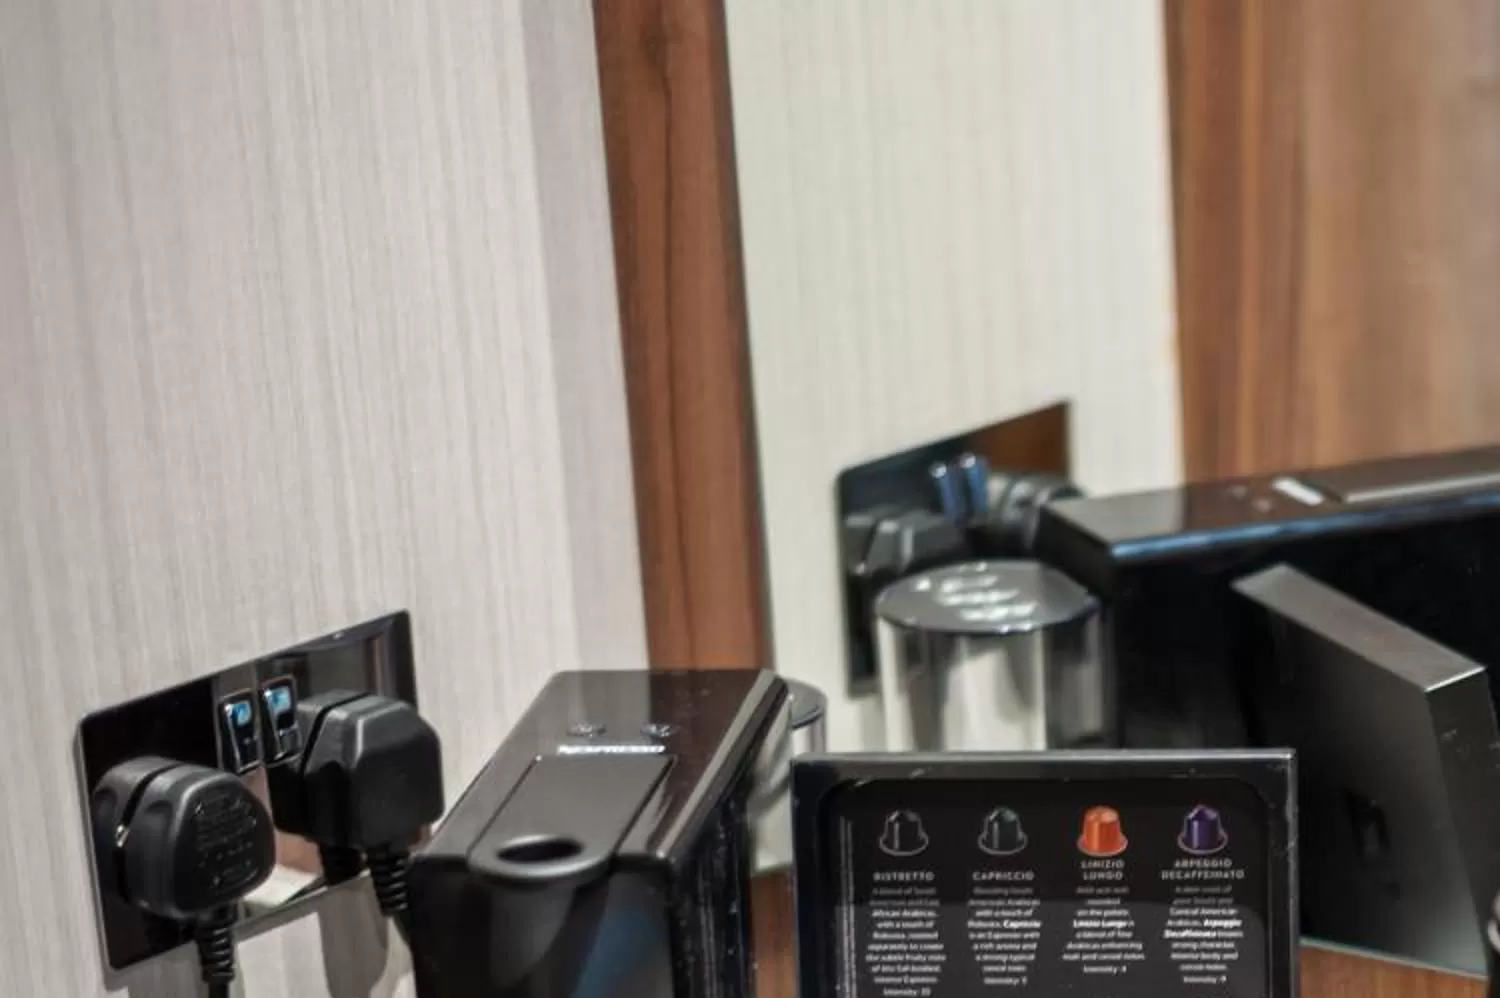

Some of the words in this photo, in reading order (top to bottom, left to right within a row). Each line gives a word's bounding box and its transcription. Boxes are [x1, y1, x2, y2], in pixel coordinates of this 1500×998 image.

[1081, 859, 1124, 869] LINIZIO
[1175, 858, 1232, 868] ARPEGGIO
[873, 871, 935, 881] RISTRETTO
[972, 871, 1034, 881] CAPRICCIO
[1083, 871, 1123, 881] LUNGO
[1161, 869, 1245, 880] DECAFFEINATO
